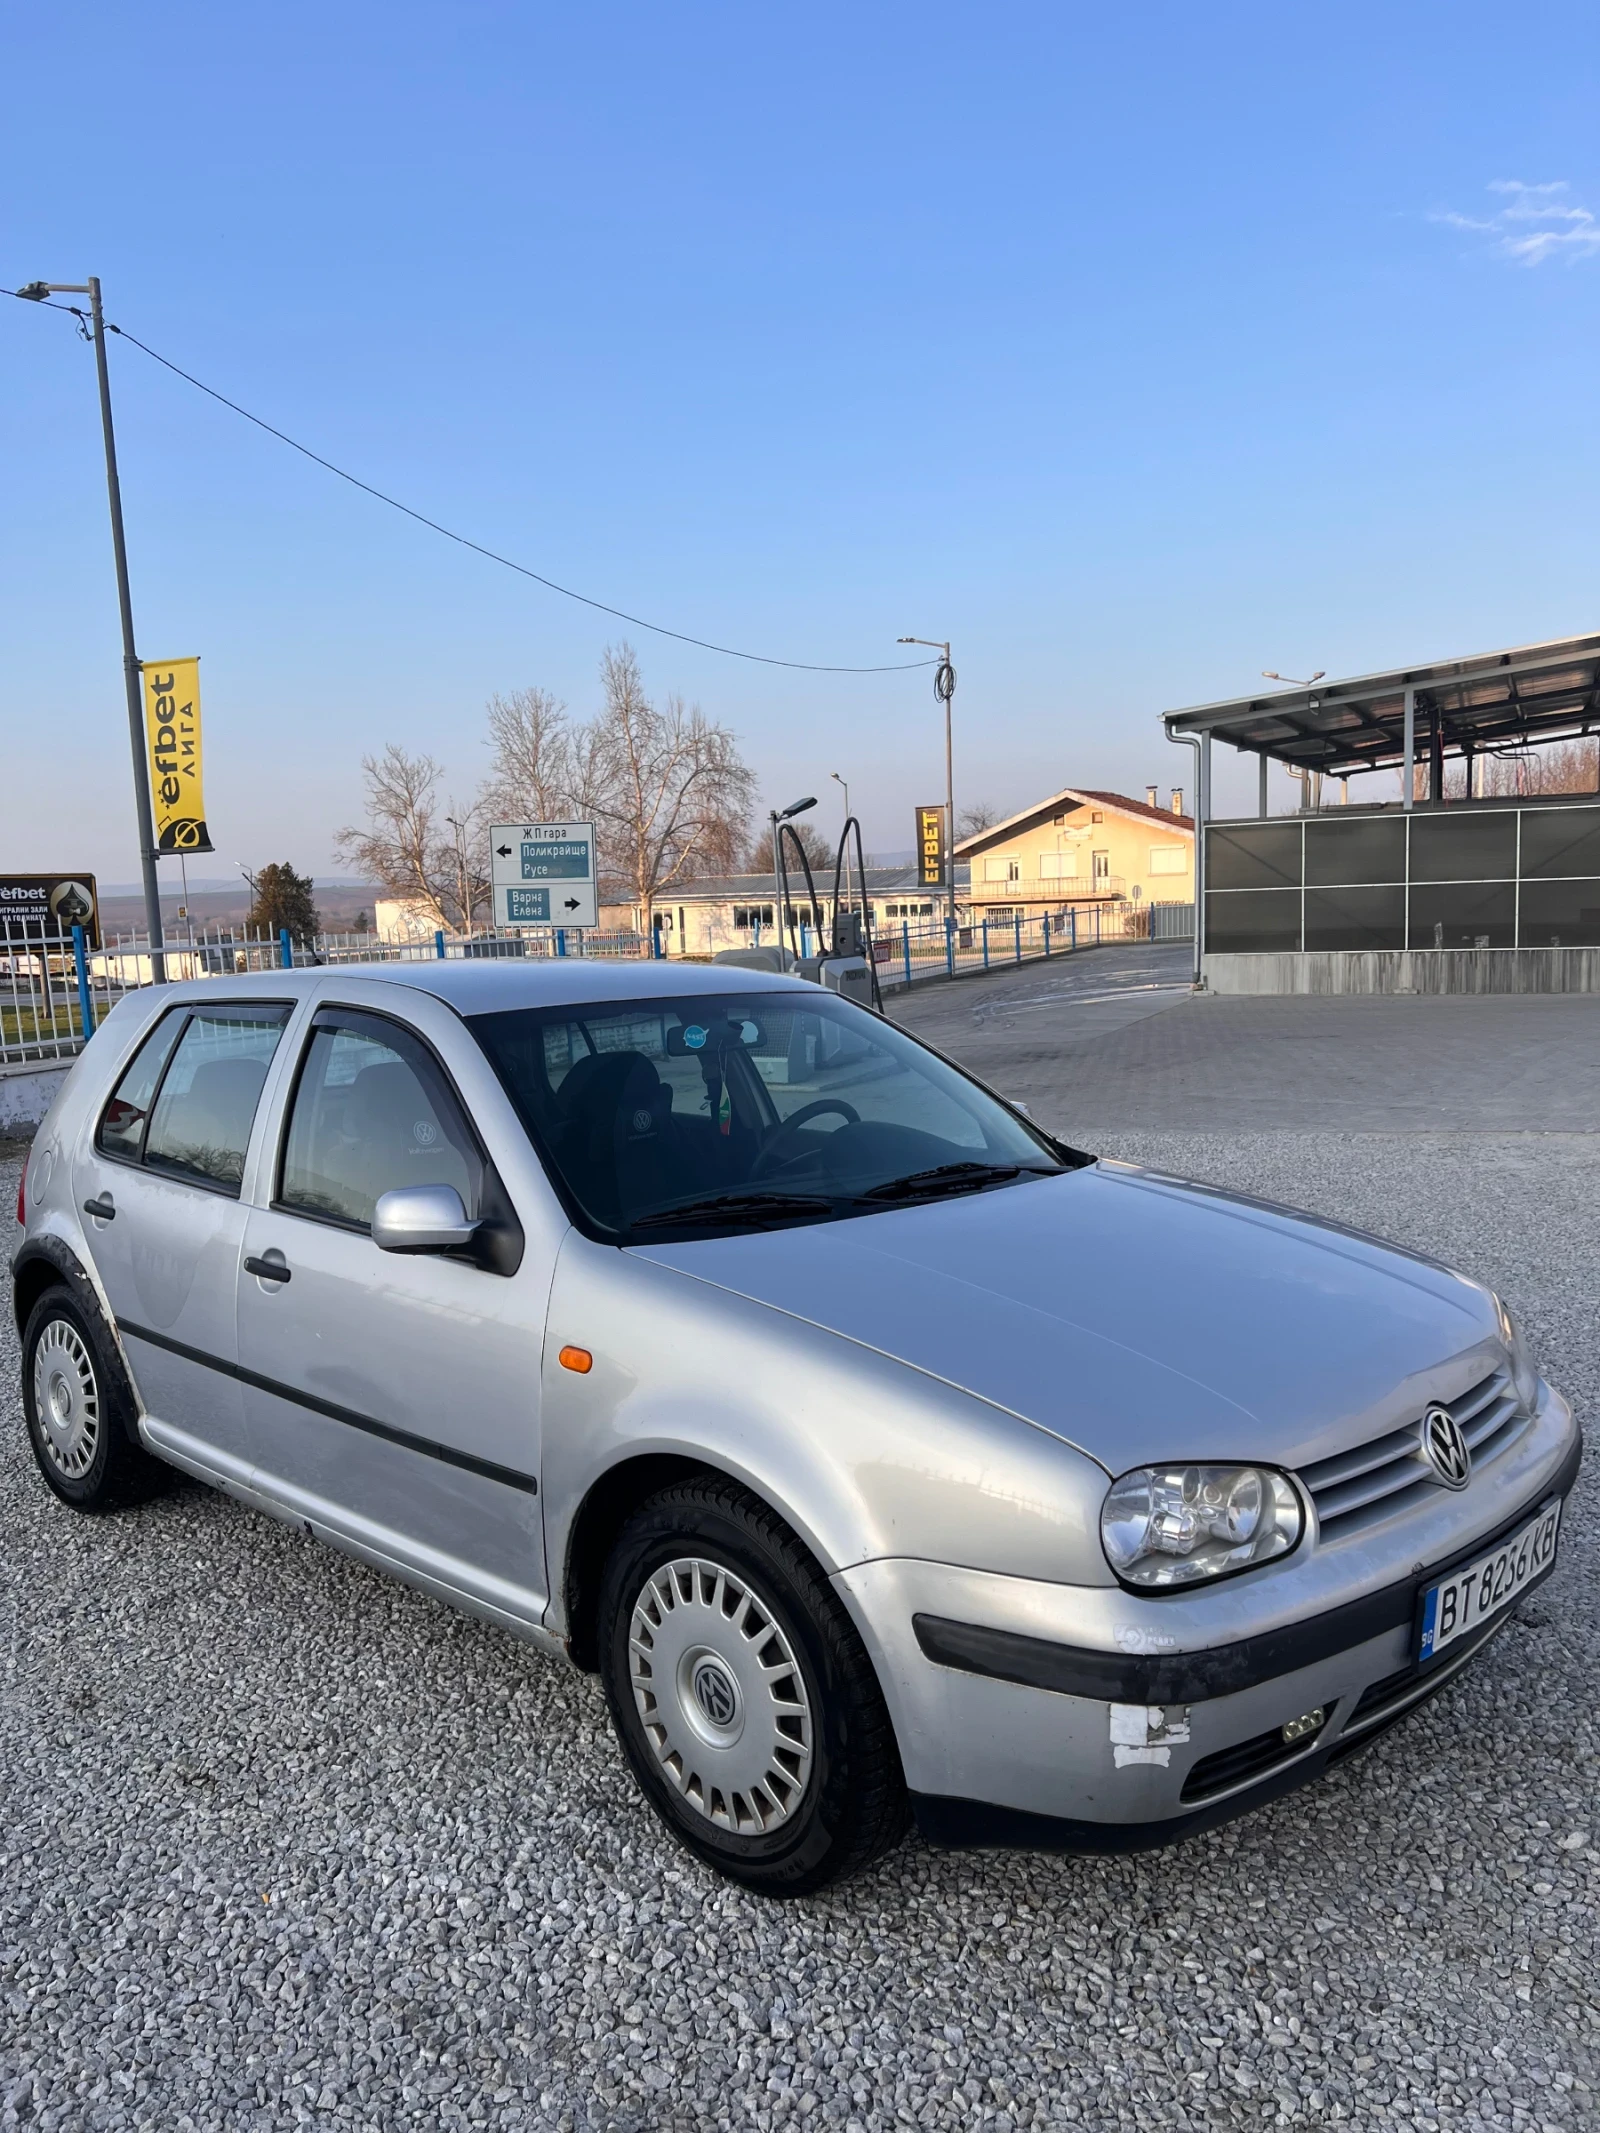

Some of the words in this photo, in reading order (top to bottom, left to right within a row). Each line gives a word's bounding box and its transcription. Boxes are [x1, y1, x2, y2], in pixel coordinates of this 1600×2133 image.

[179, 701, 196, 778] ЛИГА
[523, 844, 586, 859] Поликрайще
[922, 811, 939, 883] EFBET
[524, 863, 548, 877] Русе
[512, 891, 542, 905] Варна
[0, 906, 30, 914] ИГРАЛНИ
[513, 904, 542, 916] Елена
[13, 914, 47, 922] ГОДИНАТА
